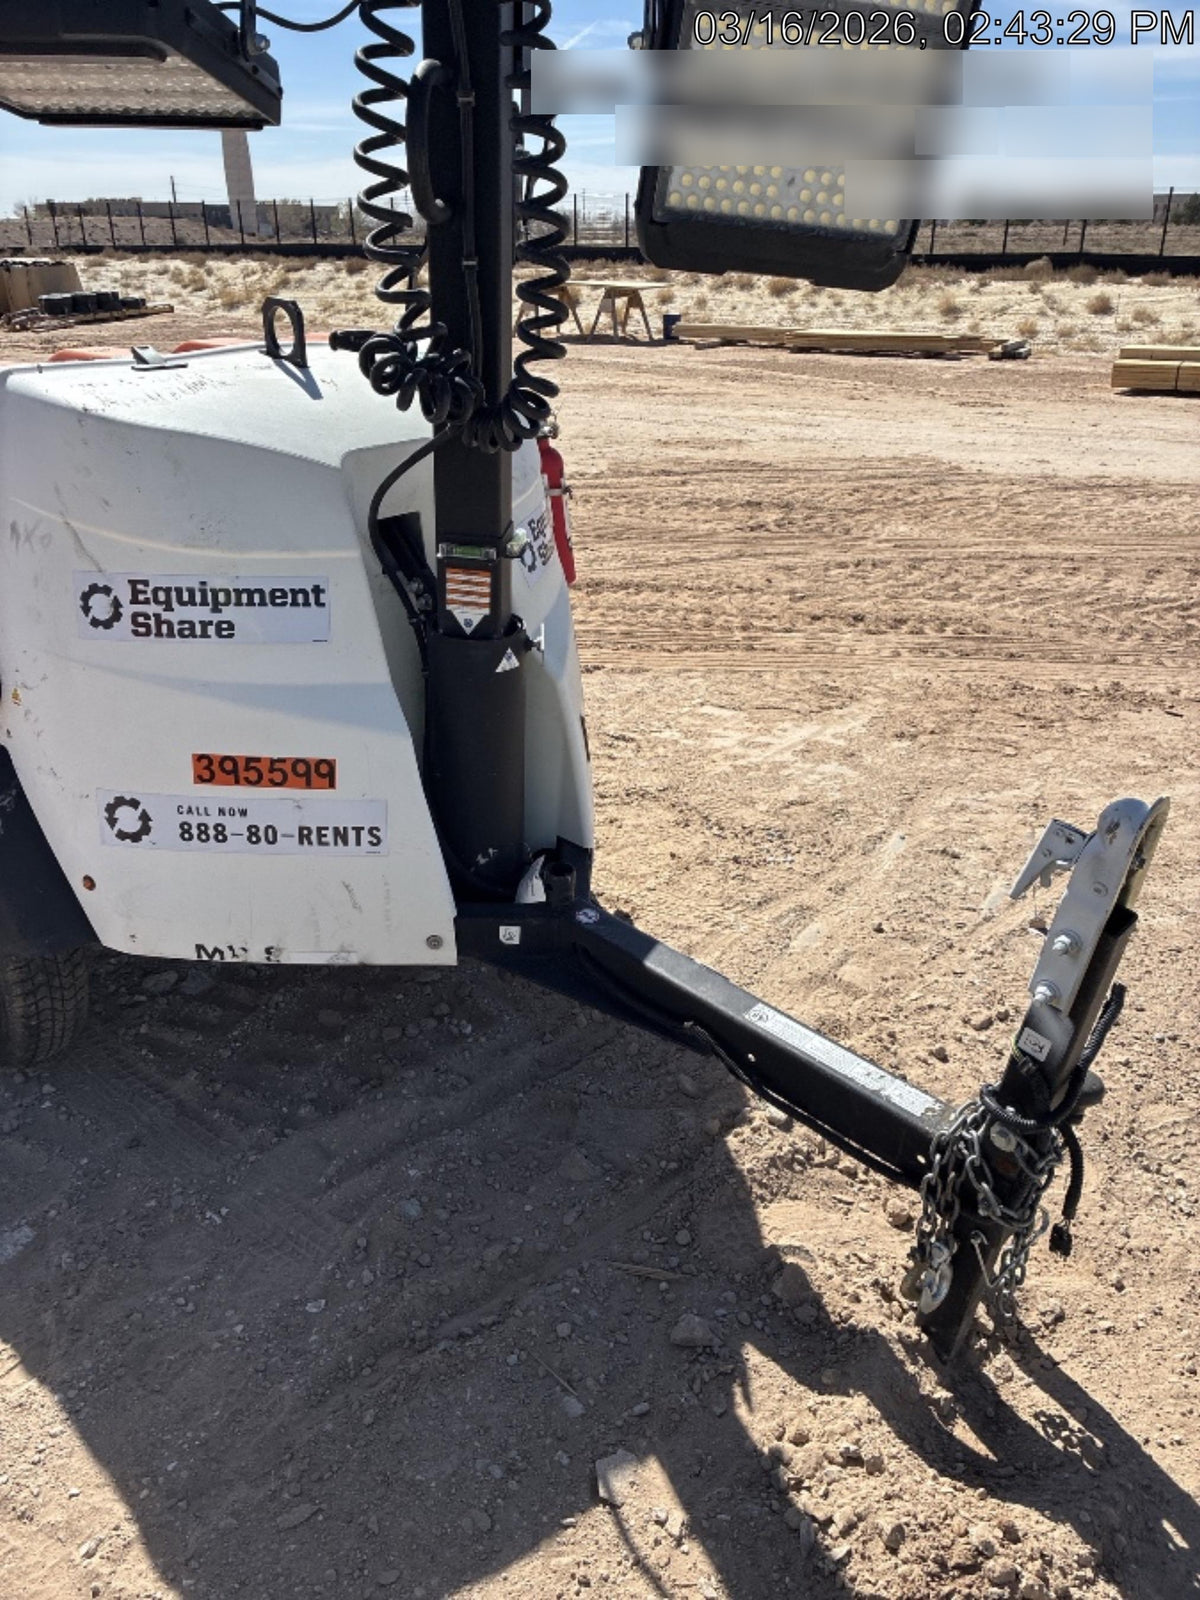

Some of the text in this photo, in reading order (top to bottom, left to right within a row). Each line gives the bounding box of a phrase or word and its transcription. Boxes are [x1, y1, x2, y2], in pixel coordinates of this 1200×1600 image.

[127, 579, 326, 613] Equipment
[131, 611, 235, 639] Share
[196, 754, 336, 789] 395599
[177, 804, 248, 818] CALL NOW
[178, 821, 382, 847] 888-80-RENTS
